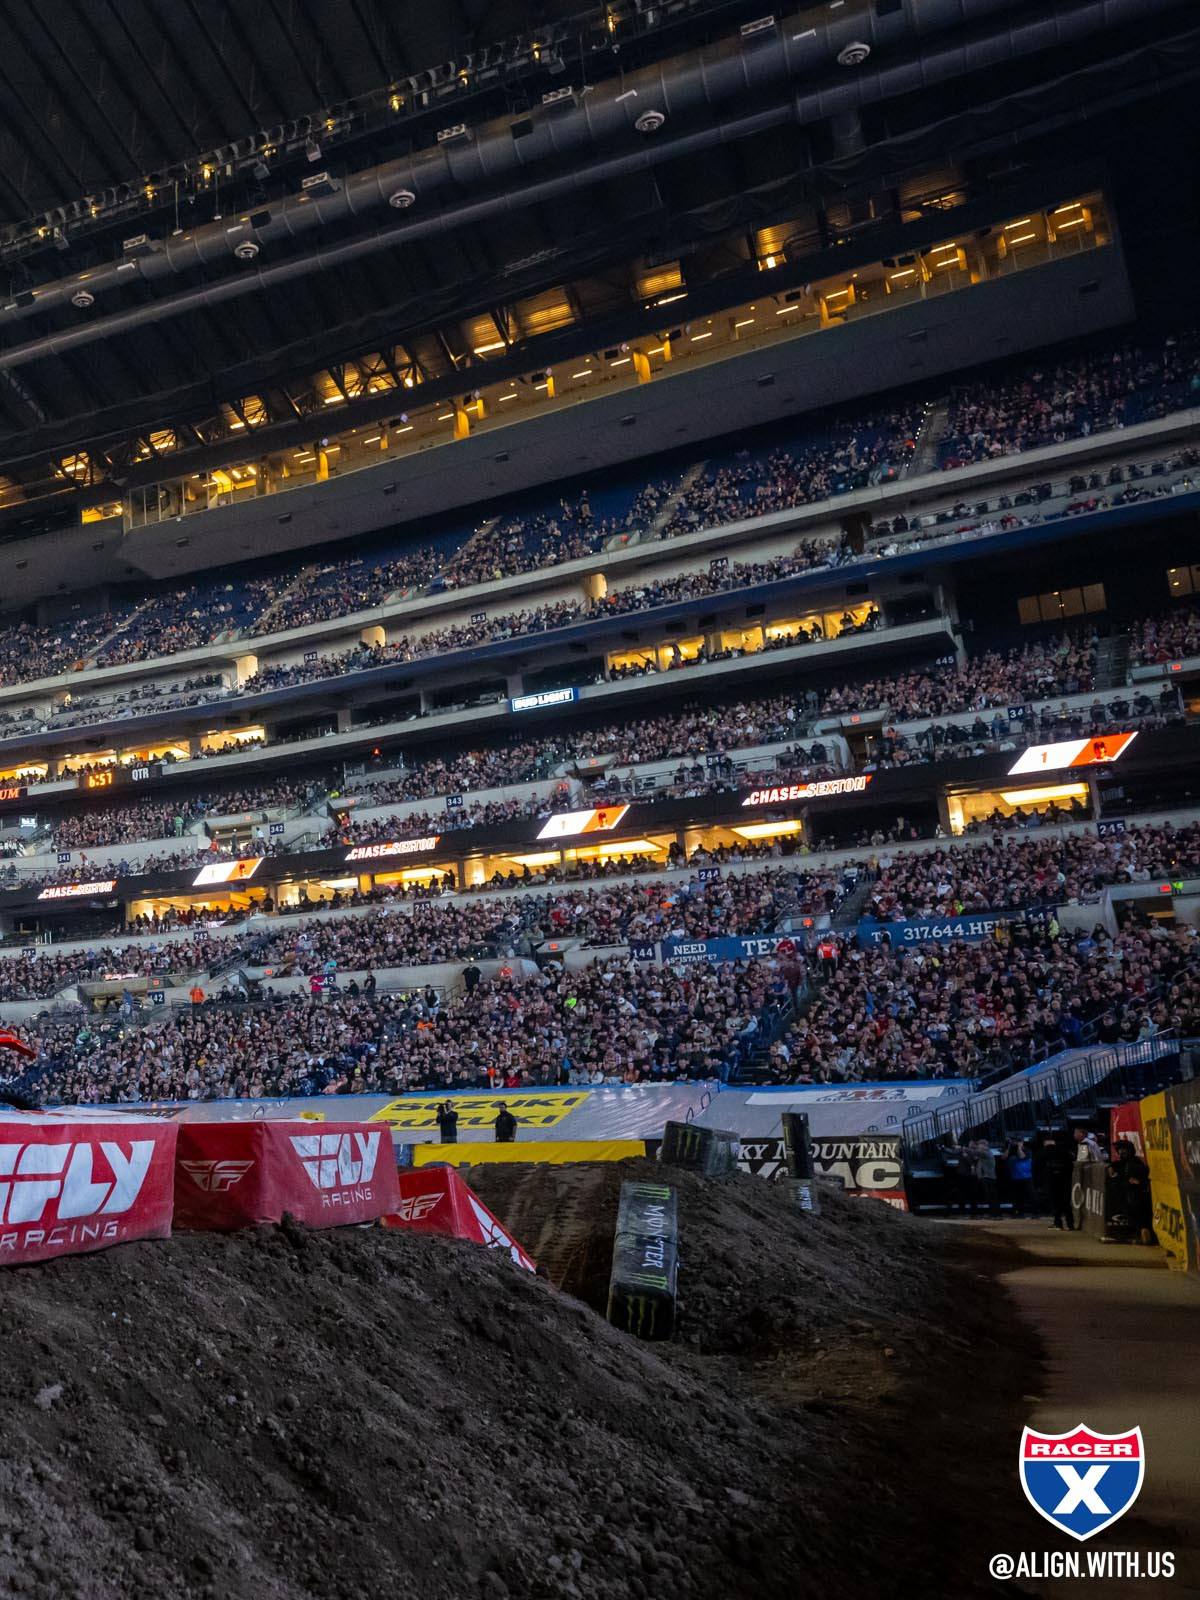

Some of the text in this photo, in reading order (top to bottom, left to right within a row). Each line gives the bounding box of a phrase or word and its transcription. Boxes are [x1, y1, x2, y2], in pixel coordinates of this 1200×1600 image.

[935, 656, 954, 666] 445
[131, 768, 149, 781] QTR
[750, 776, 867, 805] CHASE SEXTON
[447, 797, 462, 806] 343
[270, 824, 284, 834] 342
[1099, 822, 1125, 835] 245
[58, 854, 69, 862] 341
[351, 845, 387, 860] CHASE
[701, 869, 719, 880] 244
[43, 886, 72, 899] CHASE
[633, 947, 653, 959] 144
[673, 943, 707, 956] NEED
[390, 1097, 579, 1111] SUZUKI
[289, 1131, 381, 1189] FLY
[323, 1188, 373, 1208] RACING
